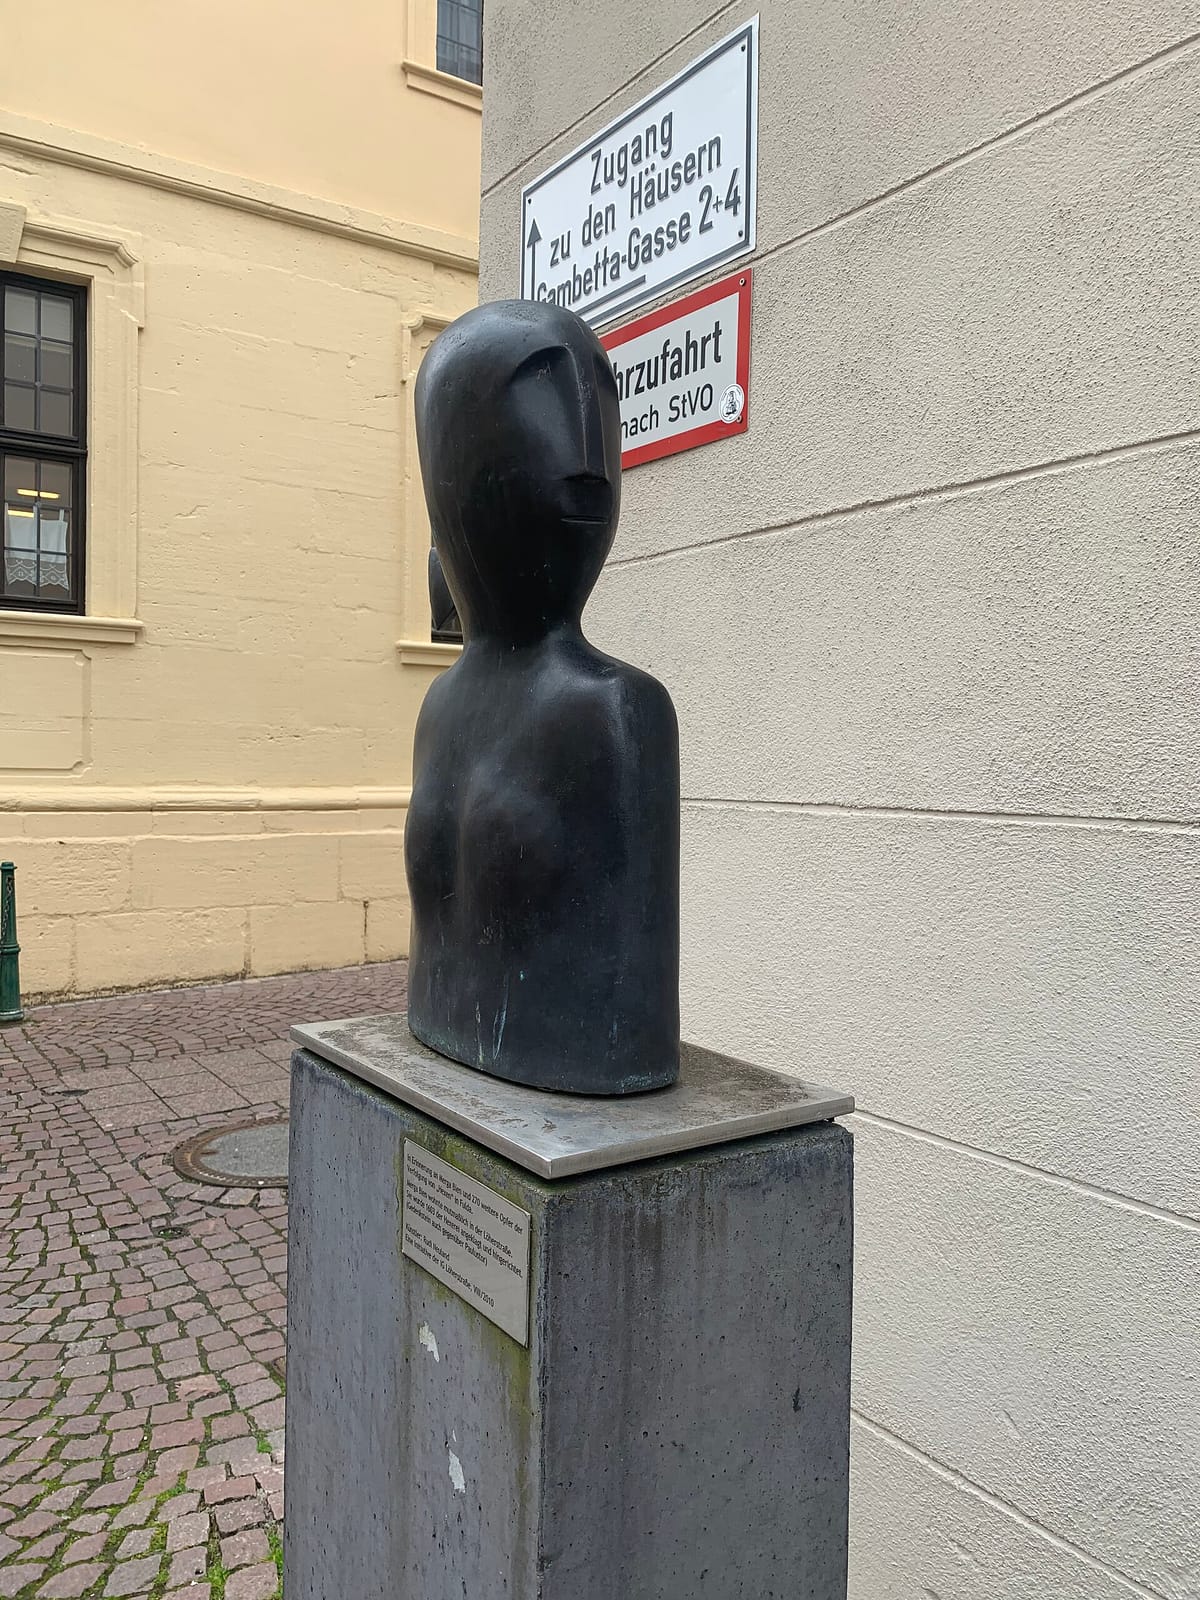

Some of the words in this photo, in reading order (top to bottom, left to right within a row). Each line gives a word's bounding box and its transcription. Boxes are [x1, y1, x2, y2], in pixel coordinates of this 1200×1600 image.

[590, 111, 674, 194] Zugang
[549, 230, 571, 267] zu
[581, 202, 617, 247] den
[629, 134, 722, 219] Häusern
[537, 210, 691, 308] Gambetta-Gasse
[699, 167, 741, 235] 2+4
[621, 404, 659, 439] nach
[668, 383, 714, 423] StVO
[412, 1155, 433, 1177] Erinnerung
[463, 1190, 472, 1200] und
[472, 1193, 481, 1206] 270
[481, 1201, 499, 1218] weitere
[499, 1212, 514, 1228] Opfer
[514, 1223, 523, 1234] der
[428, 1179, 436, 1188] von
[460, 1198, 474, 1214] Fulda.
[428, 1194, 443, 1209] wohnte
[470, 1220, 474, 1230] in
[475, 1224, 483, 1235] der
[413, 1195, 425, 1208] wurde
[461, 1228, 482, 1249] angeklagt
[483, 1243, 492, 1255] und
[432, 1219, 442, 1231] auch
[433, 1242, 450, 1261] Neuland
[432, 1253, 440, 1264] der
